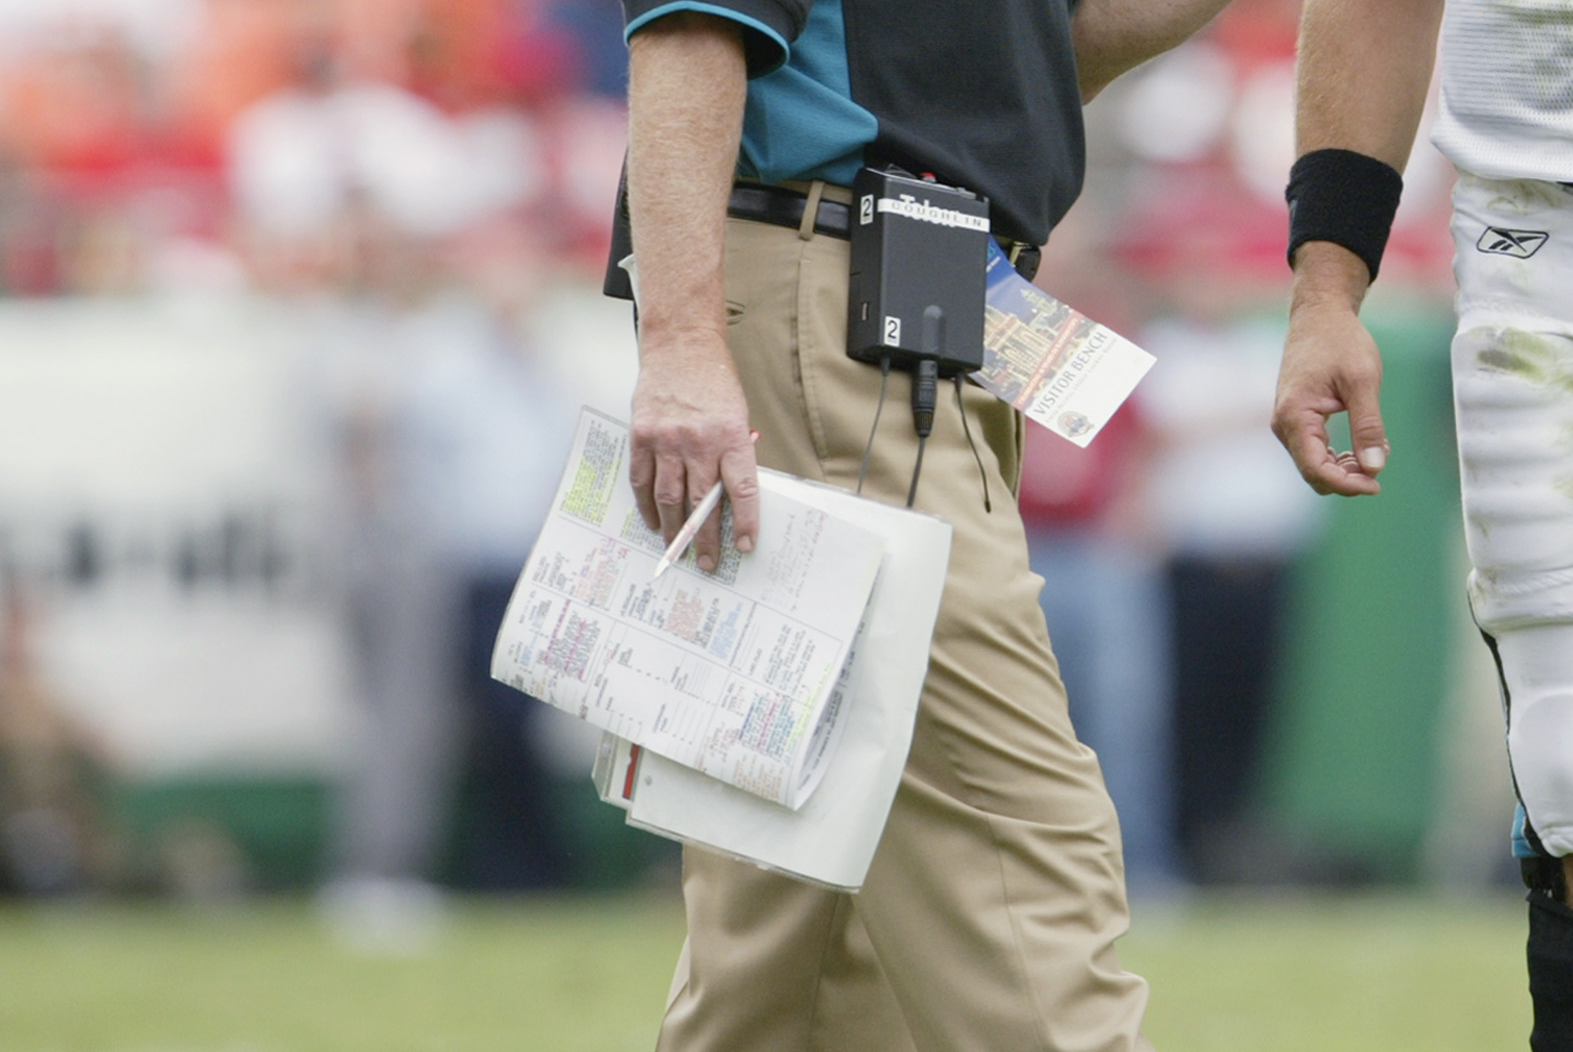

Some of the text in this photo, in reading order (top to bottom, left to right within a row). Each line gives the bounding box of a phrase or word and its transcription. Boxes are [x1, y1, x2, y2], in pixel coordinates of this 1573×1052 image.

[862, 198, 872, 217] 2
[891, 201, 983, 228] COUGHLIN
[887, 319, 898, 340] 2
[1032, 370, 1077, 415] VISITOR
[1070, 331, 1108, 371] BENCH
